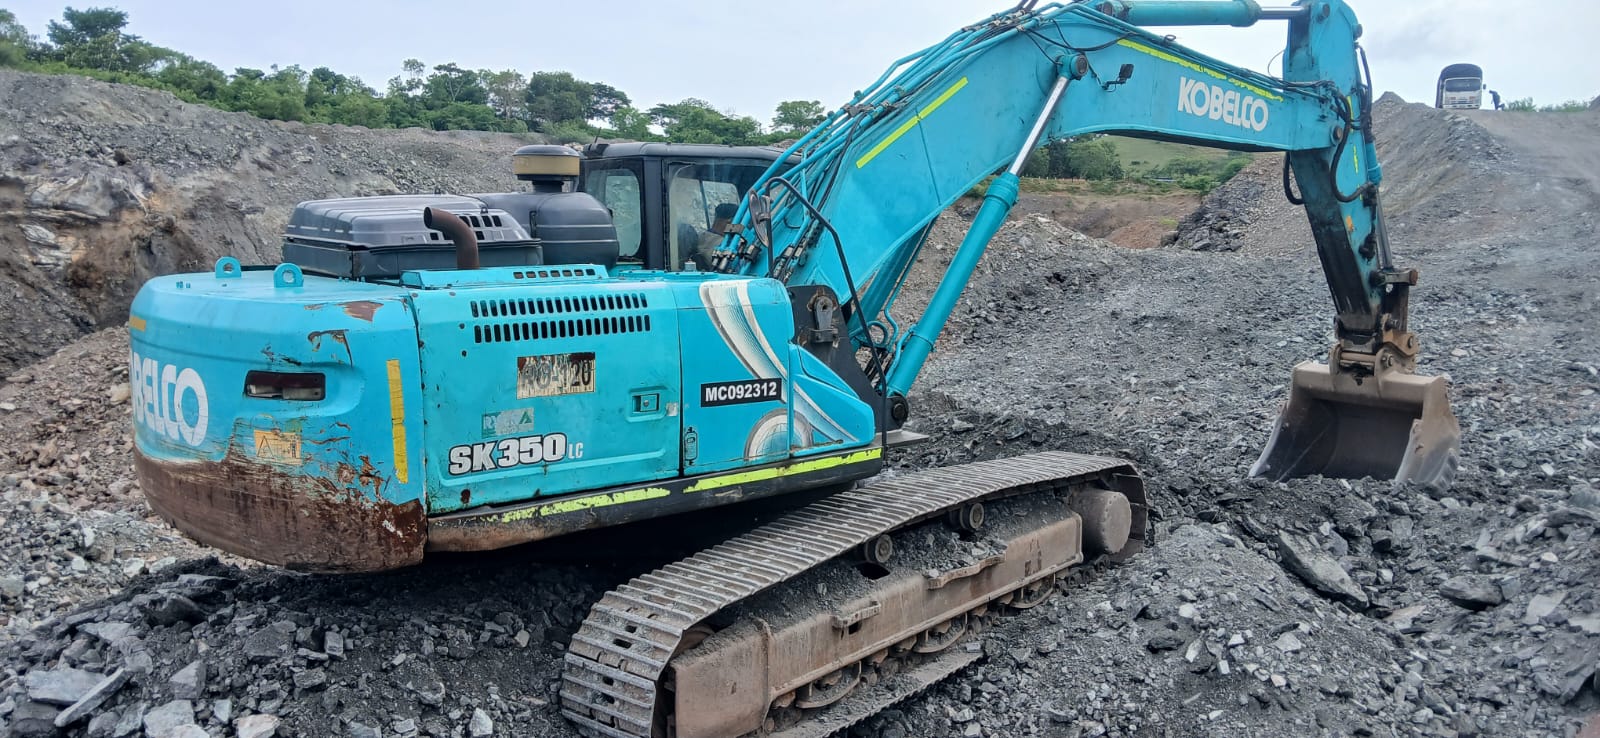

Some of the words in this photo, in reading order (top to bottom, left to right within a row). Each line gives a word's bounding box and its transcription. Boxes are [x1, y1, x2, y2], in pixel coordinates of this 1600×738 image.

[1177, 76, 1268, 131] KOBELCO
[130, 348, 208, 446] BELCO
[705, 382, 777, 401] MC092312
[449, 433, 567, 475] SK350
[568, 442, 583, 459] LC
